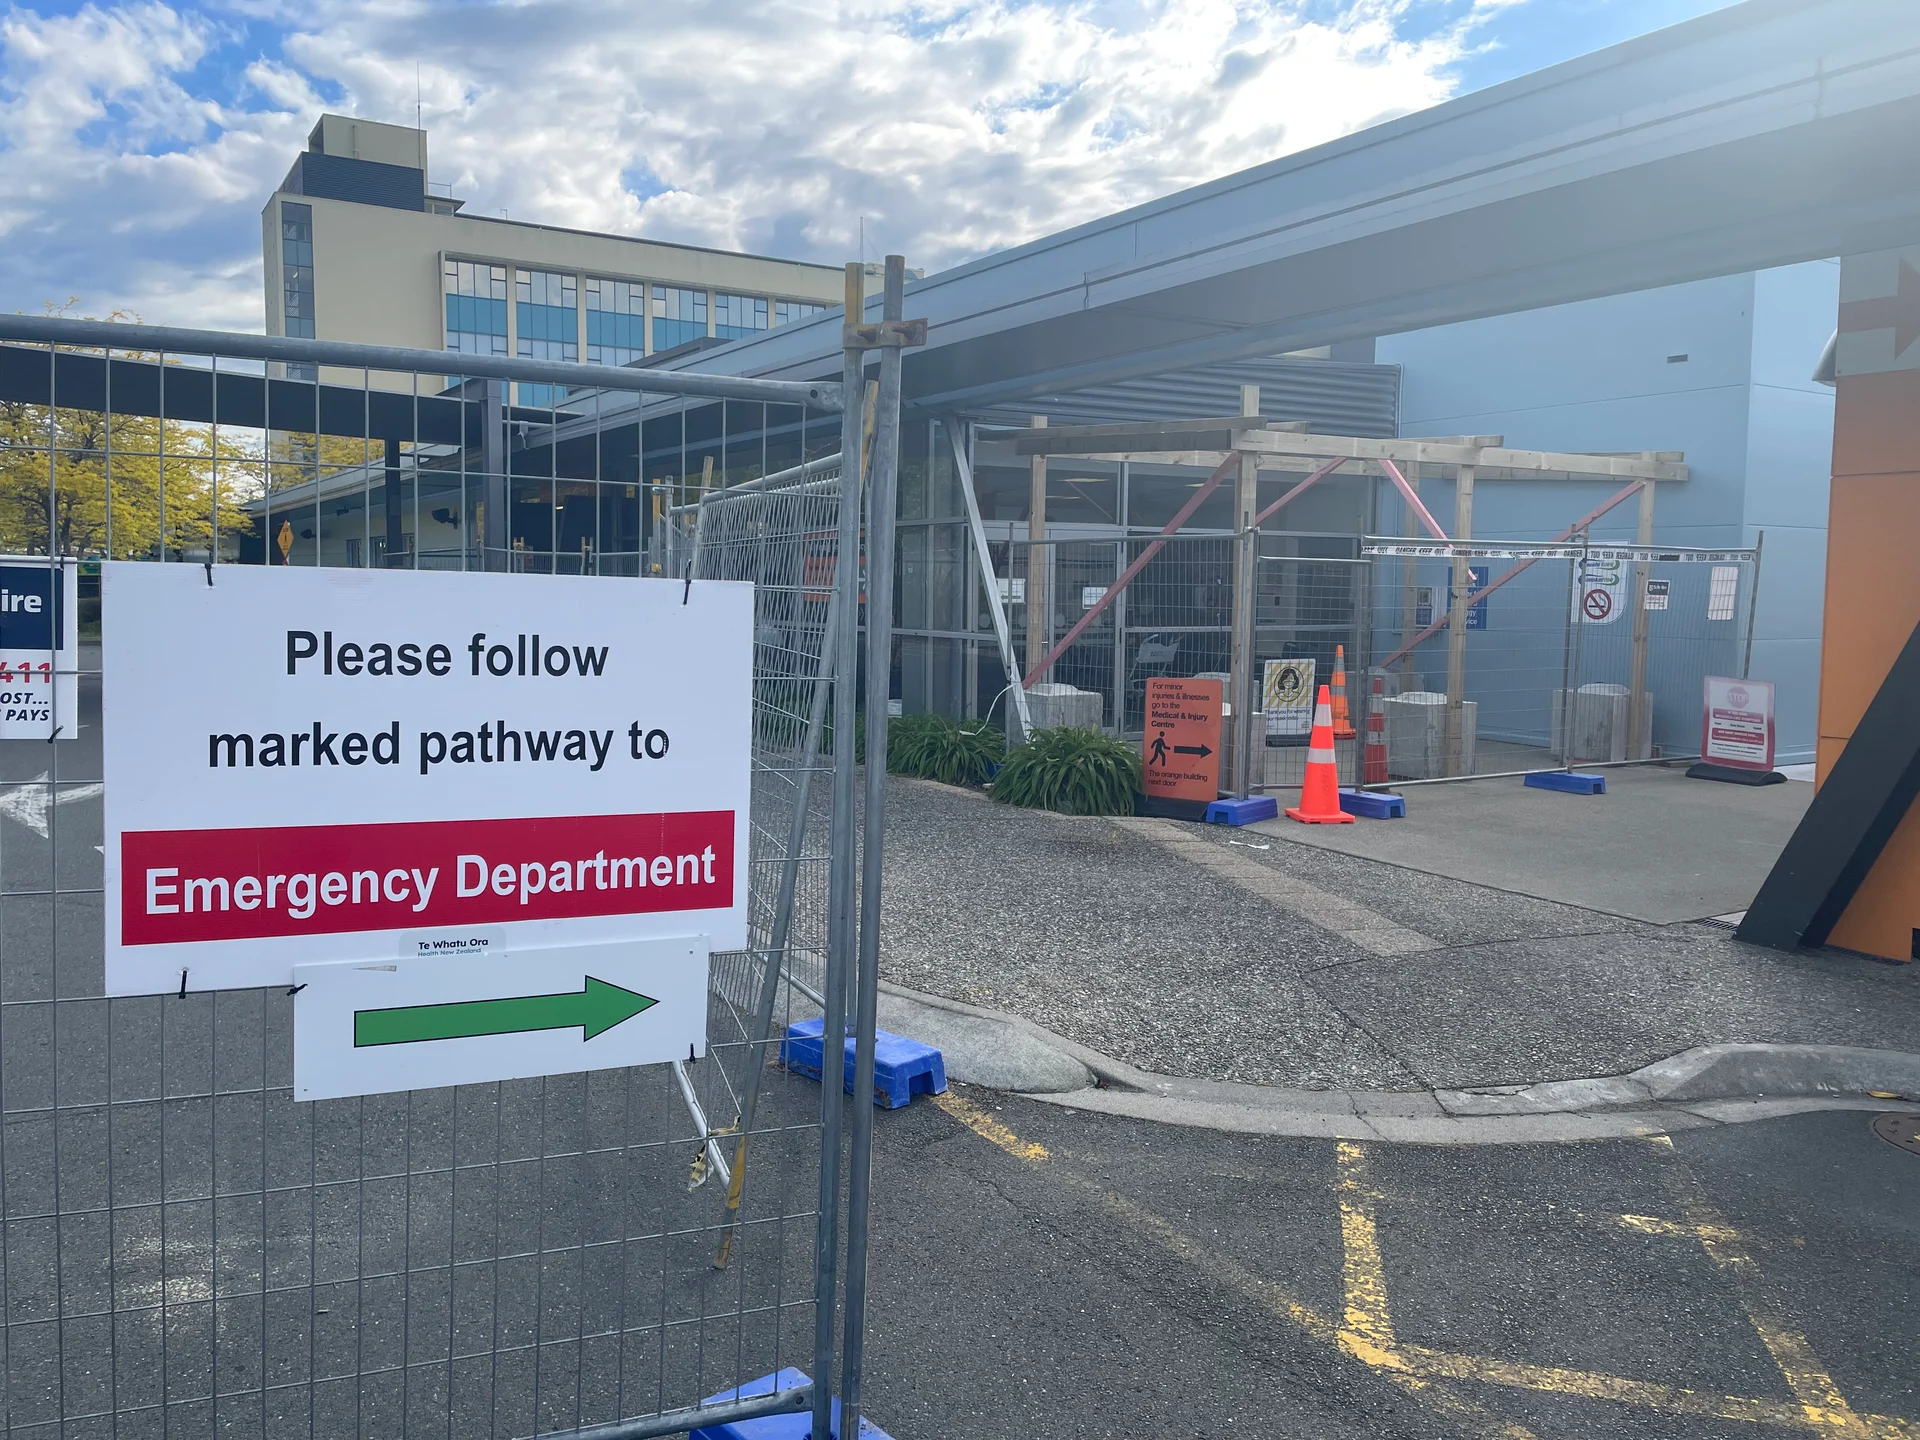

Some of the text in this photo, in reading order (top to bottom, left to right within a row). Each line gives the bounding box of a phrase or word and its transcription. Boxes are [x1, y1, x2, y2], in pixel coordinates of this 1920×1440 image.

[2, 589, 42, 613] ire
[287, 631, 610, 677] Please follow
[1152, 682, 1163, 690] For
[1151, 692, 1175, 700] injuries
[1182, 693, 1210, 701] illnesses
[1727, 692, 1749, 702] STOP
[6, 709, 49, 722] PAYS
[1151, 711, 1208, 721] Medical & Injury
[1151, 720, 1175, 728] Centre
[209, 720, 670, 776] marked pathway to
[1161, 772, 1183, 780] orange
[1183, 771, 1208, 782] building
[146, 844, 716, 920] Emergency Department
[418, 938, 489, 950] Te Whatu Ora
